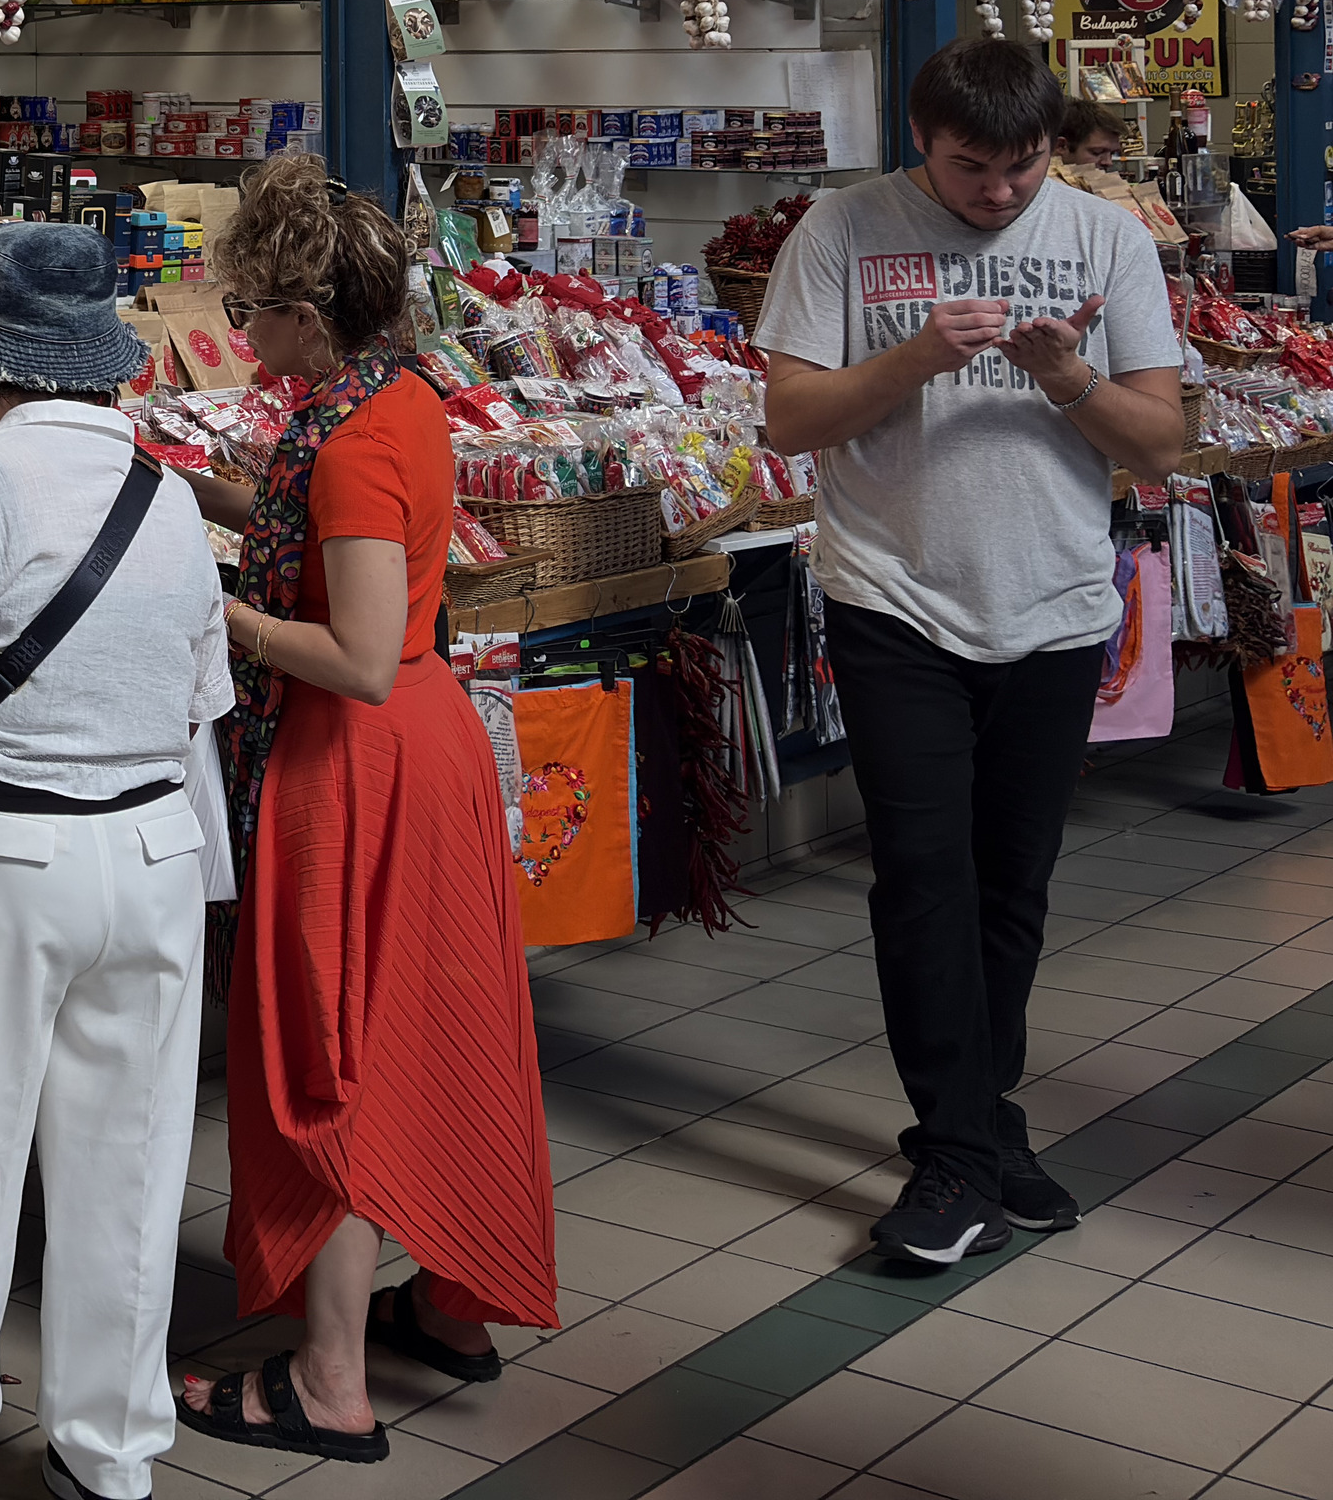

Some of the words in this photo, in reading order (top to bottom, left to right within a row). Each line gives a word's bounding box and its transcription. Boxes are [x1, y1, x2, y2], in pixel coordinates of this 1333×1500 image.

[1080, 14, 1139, 34] Budapest
[861, 256, 934, 295] DIESEL
[938, 252, 1097, 303] DIESEL
[879, 291, 912, 300] SUCCESSFUL
